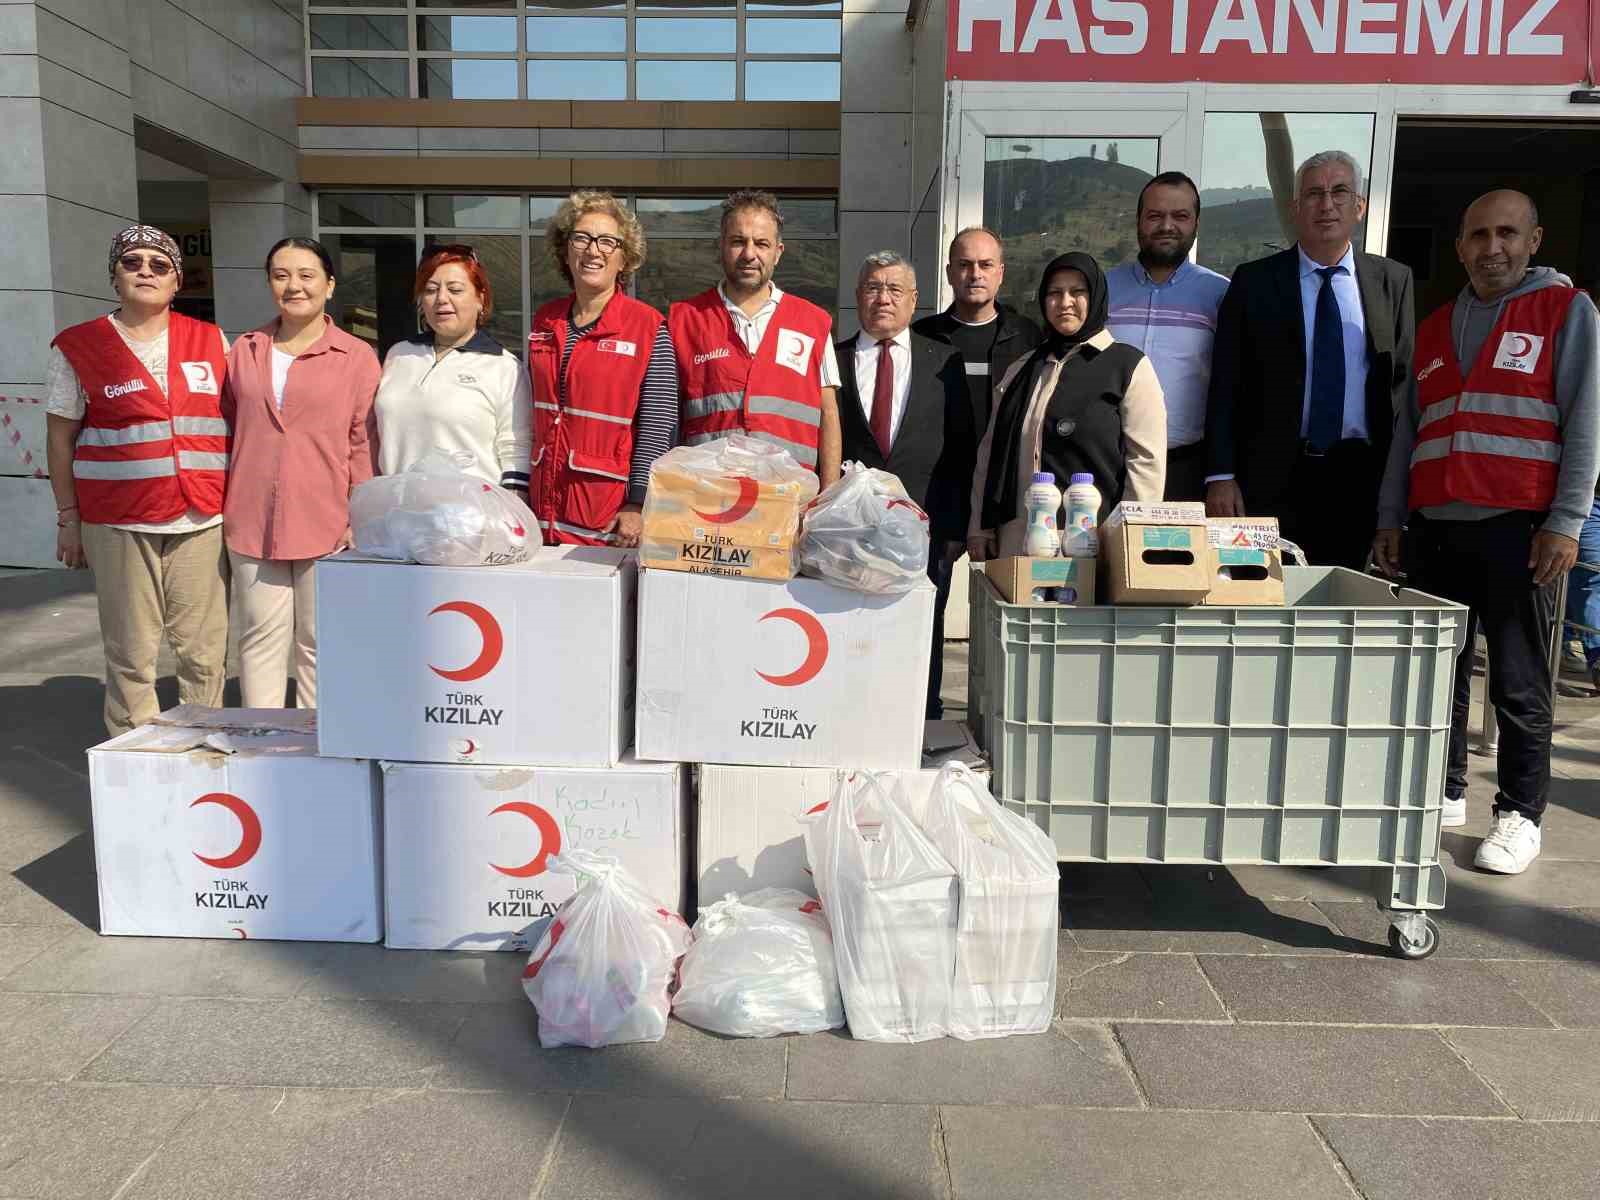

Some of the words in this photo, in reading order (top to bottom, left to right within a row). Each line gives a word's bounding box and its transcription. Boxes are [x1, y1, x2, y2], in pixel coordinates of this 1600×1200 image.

[682, 543, 752, 563] KIZILAY
[446, 691, 483, 706] TÜRK
[424, 706, 504, 726] KIZILAY
[762, 706, 799, 721] TÜRK
[741, 720, 817, 740] KIZILAY
[213, 878, 249, 892] TÜRK
[195, 892, 269, 910] KIZILAY
[508, 887, 544, 901] TÜRK
